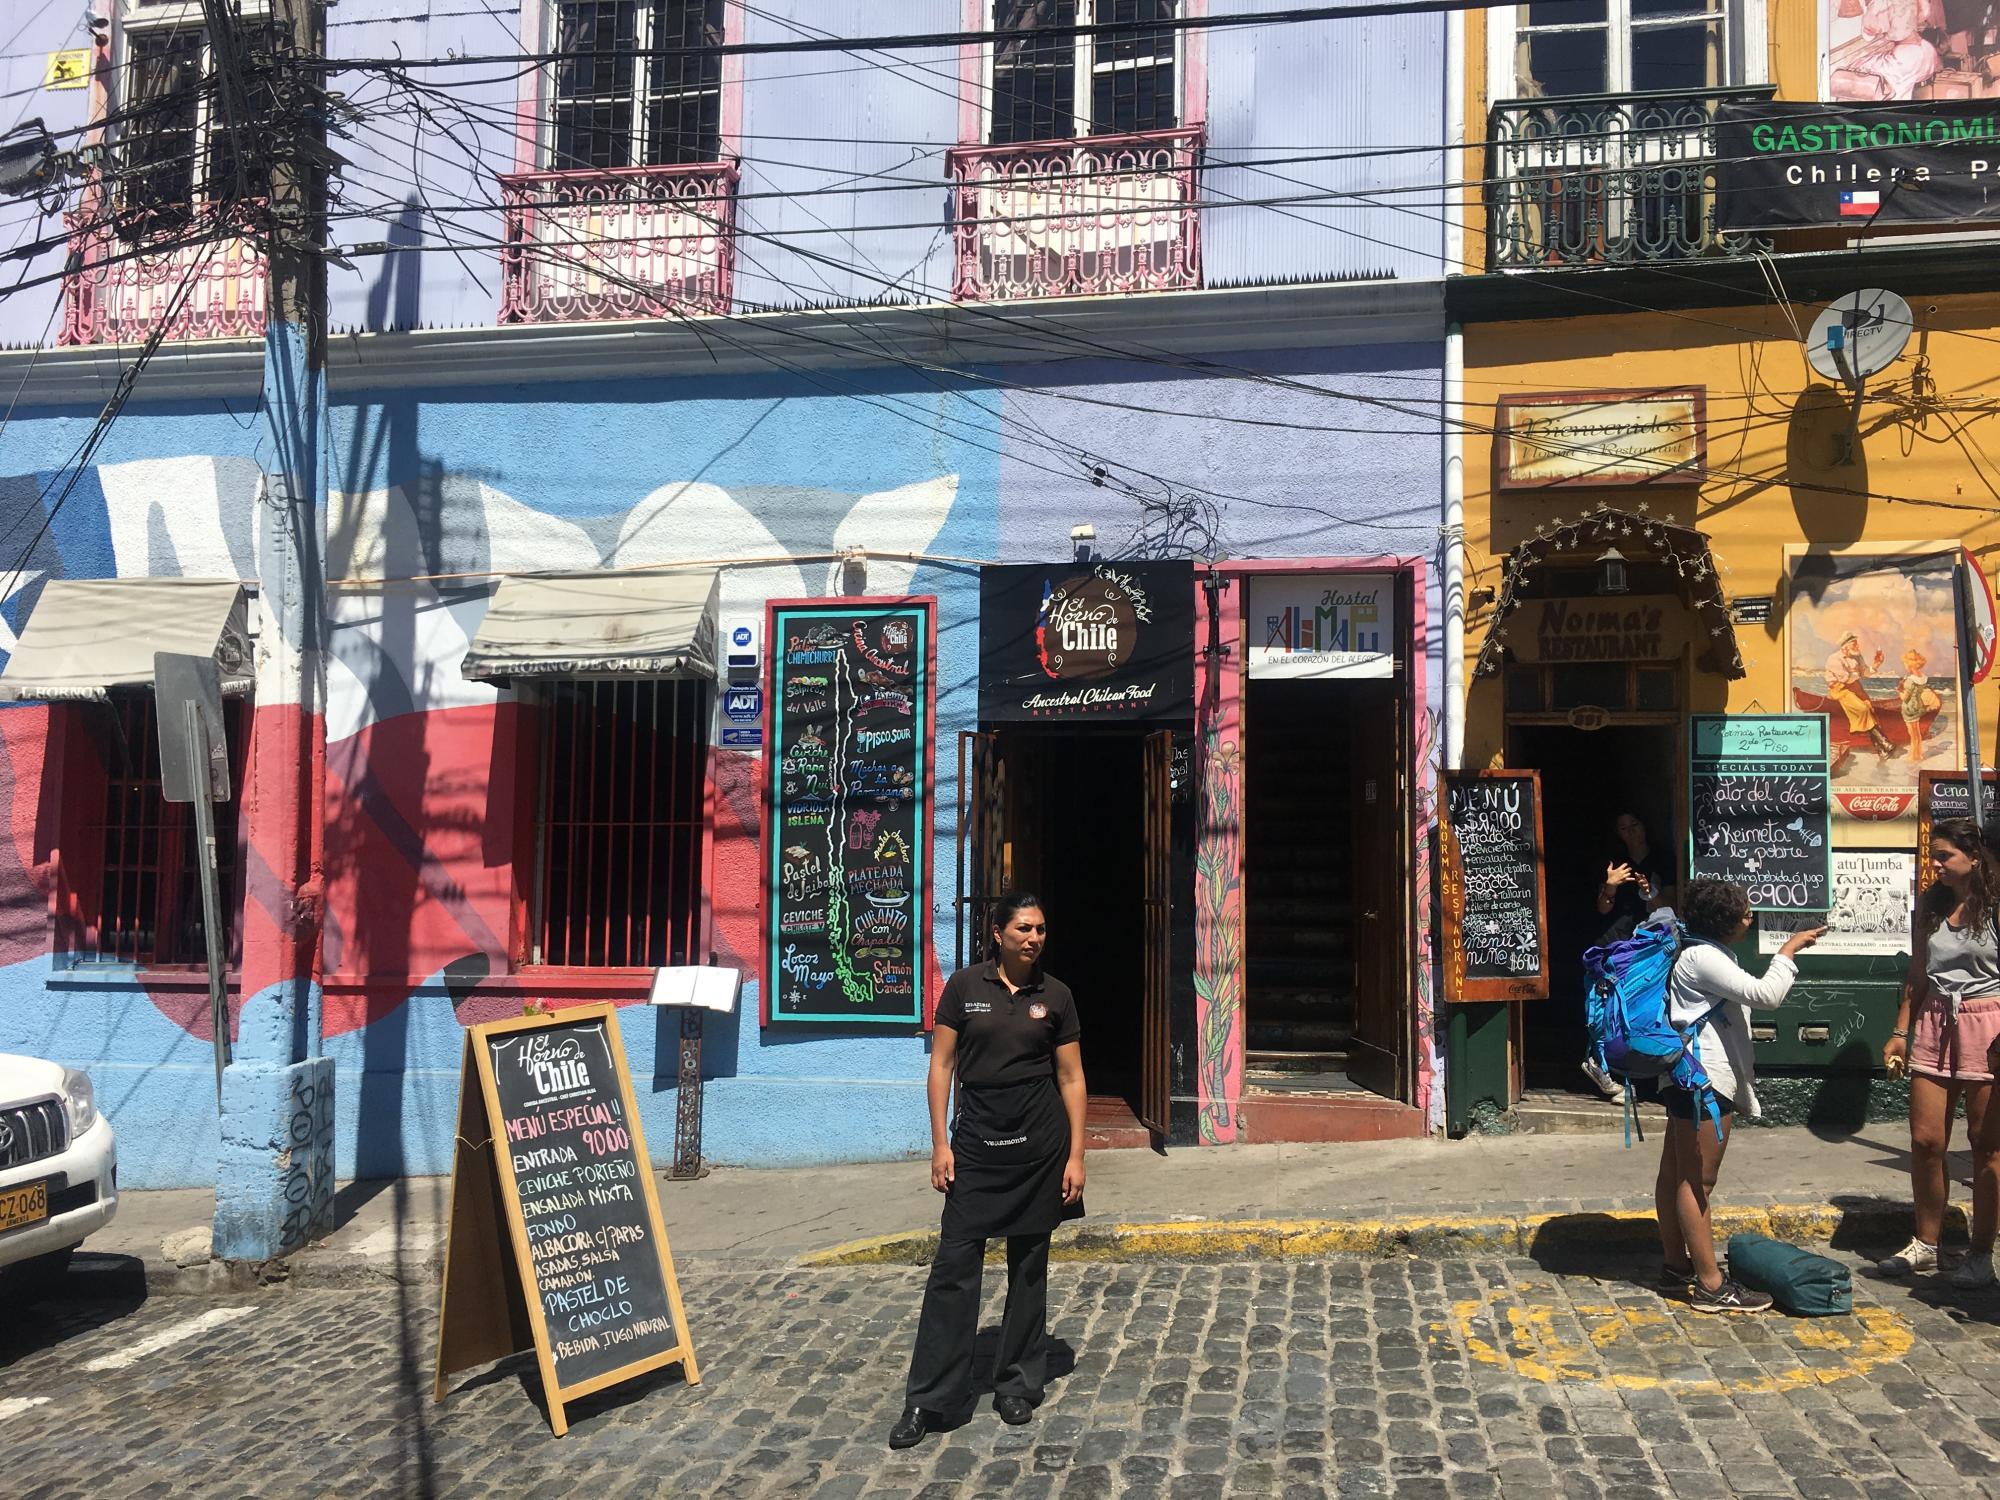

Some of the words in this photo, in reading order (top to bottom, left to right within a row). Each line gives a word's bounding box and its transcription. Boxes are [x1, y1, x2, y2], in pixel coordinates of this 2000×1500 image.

[1843, 326, 1883, 340] IRECTV
[1521, 415, 1682, 439] Bienvenidos
[1068, 598, 1084, 612] El
[1320, 589, 1379, 606] Hostal
[1049, 598, 1108, 631] Horno
[735, 632, 749, 641] ADT
[1062, 620, 1118, 651] Chile
[787, 650, 836, 665] CHIMICHURRI
[1281, 656, 1290, 664] EL
[1292, 654, 1329, 664] CORAZÓN
[1331, 655, 1346, 663] DEL
[1348, 655, 1376, 664] ALEGRE
[730, 694, 758, 710] ADT
[786, 702, 800, 714] del
[803, 699, 827, 714] Valle
[1022, 689, 1083, 709] Ancestral
[1084, 686, 1126, 706] Chilean
[1126, 682, 1156, 699] Food
[1033, 701, 1150, 716] RESTAURANT
[865, 731, 891, 753] PISCO
[891, 728, 912, 744] SOUR
[1763, 738, 1789, 752] Piso
[1705, 764, 1766, 772] SPECIALS
[1772, 764, 1814, 772] TODAY
[1451, 782, 1520, 814] MENÚ
[1747, 779, 1773, 801] del
[1780, 782, 1808, 806] día
[1933, 783, 1970, 797] Cena
[788, 813, 825, 827] ISLEÑA
[1460, 832, 1507, 844] Entrada
[1439, 820, 1450, 895] NORMAS
[1703, 847, 1721, 857] a
[1730, 843, 1749, 858] lo
[1754, 844, 1809, 869] pobre
[783, 855, 822, 885] Pastel
[848, 865, 904, 884] PLATEADA
[787, 883, 799, 900] de
[849, 877, 905, 896] MECHADA
[782, 908, 824, 923] CEVICHE
[854, 908, 908, 934] CURANTO
[871, 925, 890, 934] con
[1451, 870, 1464, 1000] RESTAURANT
[782, 943, 819, 973] Locos
[793, 965, 835, 990] Mayo
[873, 960, 912, 983] Salmón
[885, 974, 897, 984] en
[534, 1034, 549, 1051] El
[517, 1037, 573, 1076] Horno
[533, 1059, 591, 1096] Chile
[505, 1104, 547, 1143] MENÚ
[513, 1146, 579, 1174] ENTRADA
[517, 1170, 573, 1197] CEVICHE
[572, 1159, 636, 1185] PORTEÑO
[20, 1188, 45, 1214] 068
[522, 1190, 586, 1219] ENSALADA
[588, 1182, 634, 1207] MIXTA
[525, 1213, 577, 1242] FONDO
[532, 1231, 596, 1262] ALBACORA
[608, 1223, 645, 1249] PAPAS
[581, 1248, 621, 1268] SALSA
[545, 1281, 604, 1317] PASTEL
[604, 1275, 631, 1297] DE
[568, 1299, 633, 1332] CHOCLO
[556, 1335, 600, 1361] BEBIDA
[601, 1328, 633, 1351] JUGO
[633, 1315, 672, 1341] NATURAL
